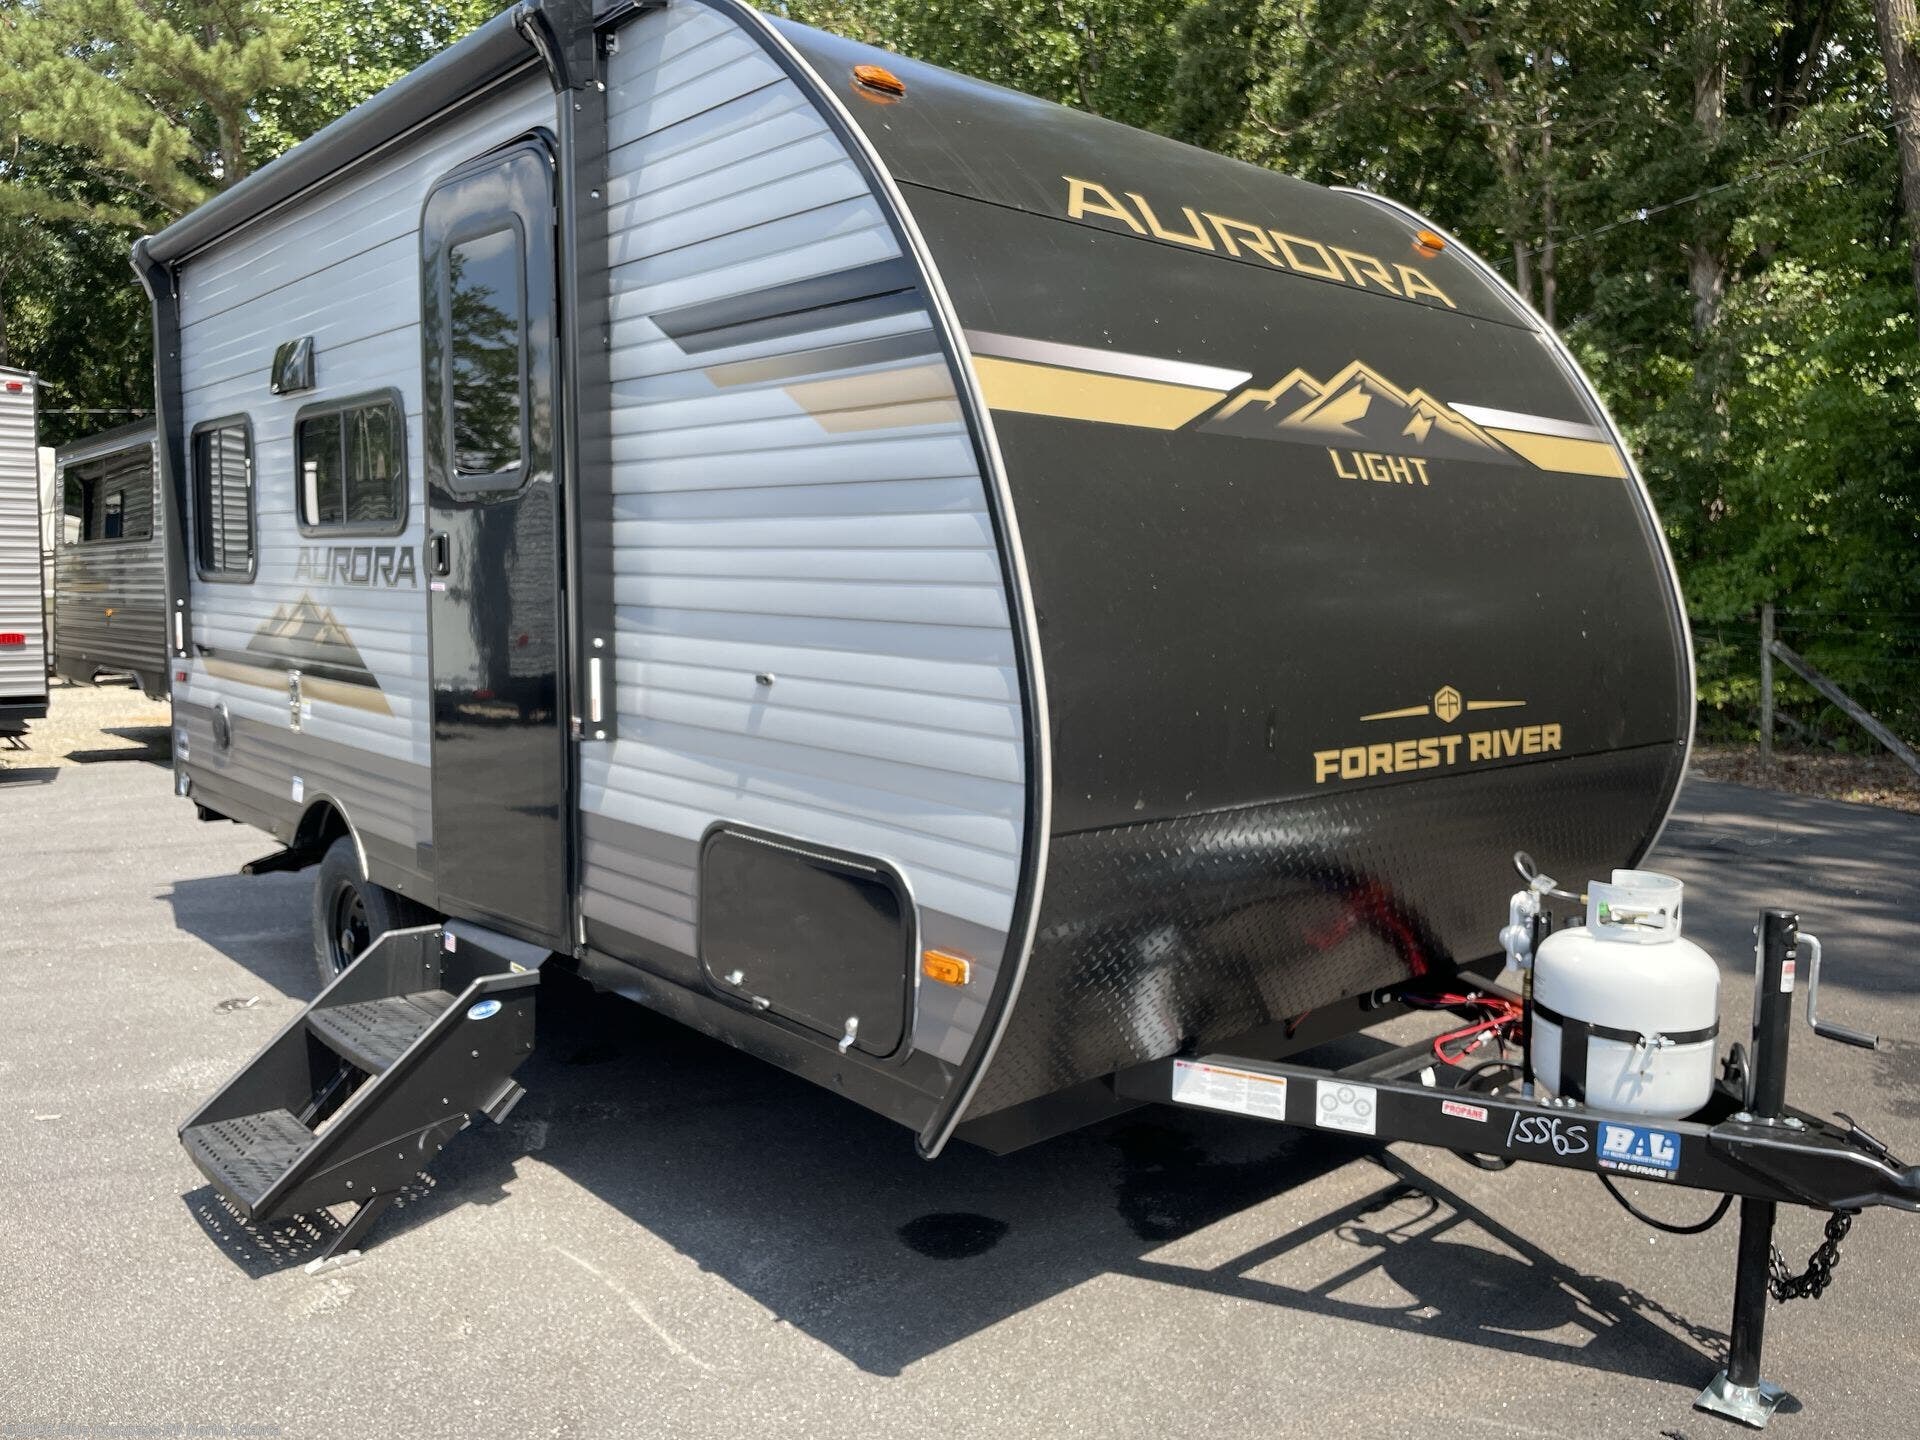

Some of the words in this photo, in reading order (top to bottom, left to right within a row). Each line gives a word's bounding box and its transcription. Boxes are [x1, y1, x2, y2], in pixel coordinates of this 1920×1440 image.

[1062, 176, 1457, 309] AURORA
[1327, 447, 1430, 486] LIGHT
[295, 546, 418, 589] AURORA
[1313, 734, 1462, 784] FOREST
[1468, 723, 1562, 762] RIVER
[1443, 1103, 1484, 1120] PROPANE
